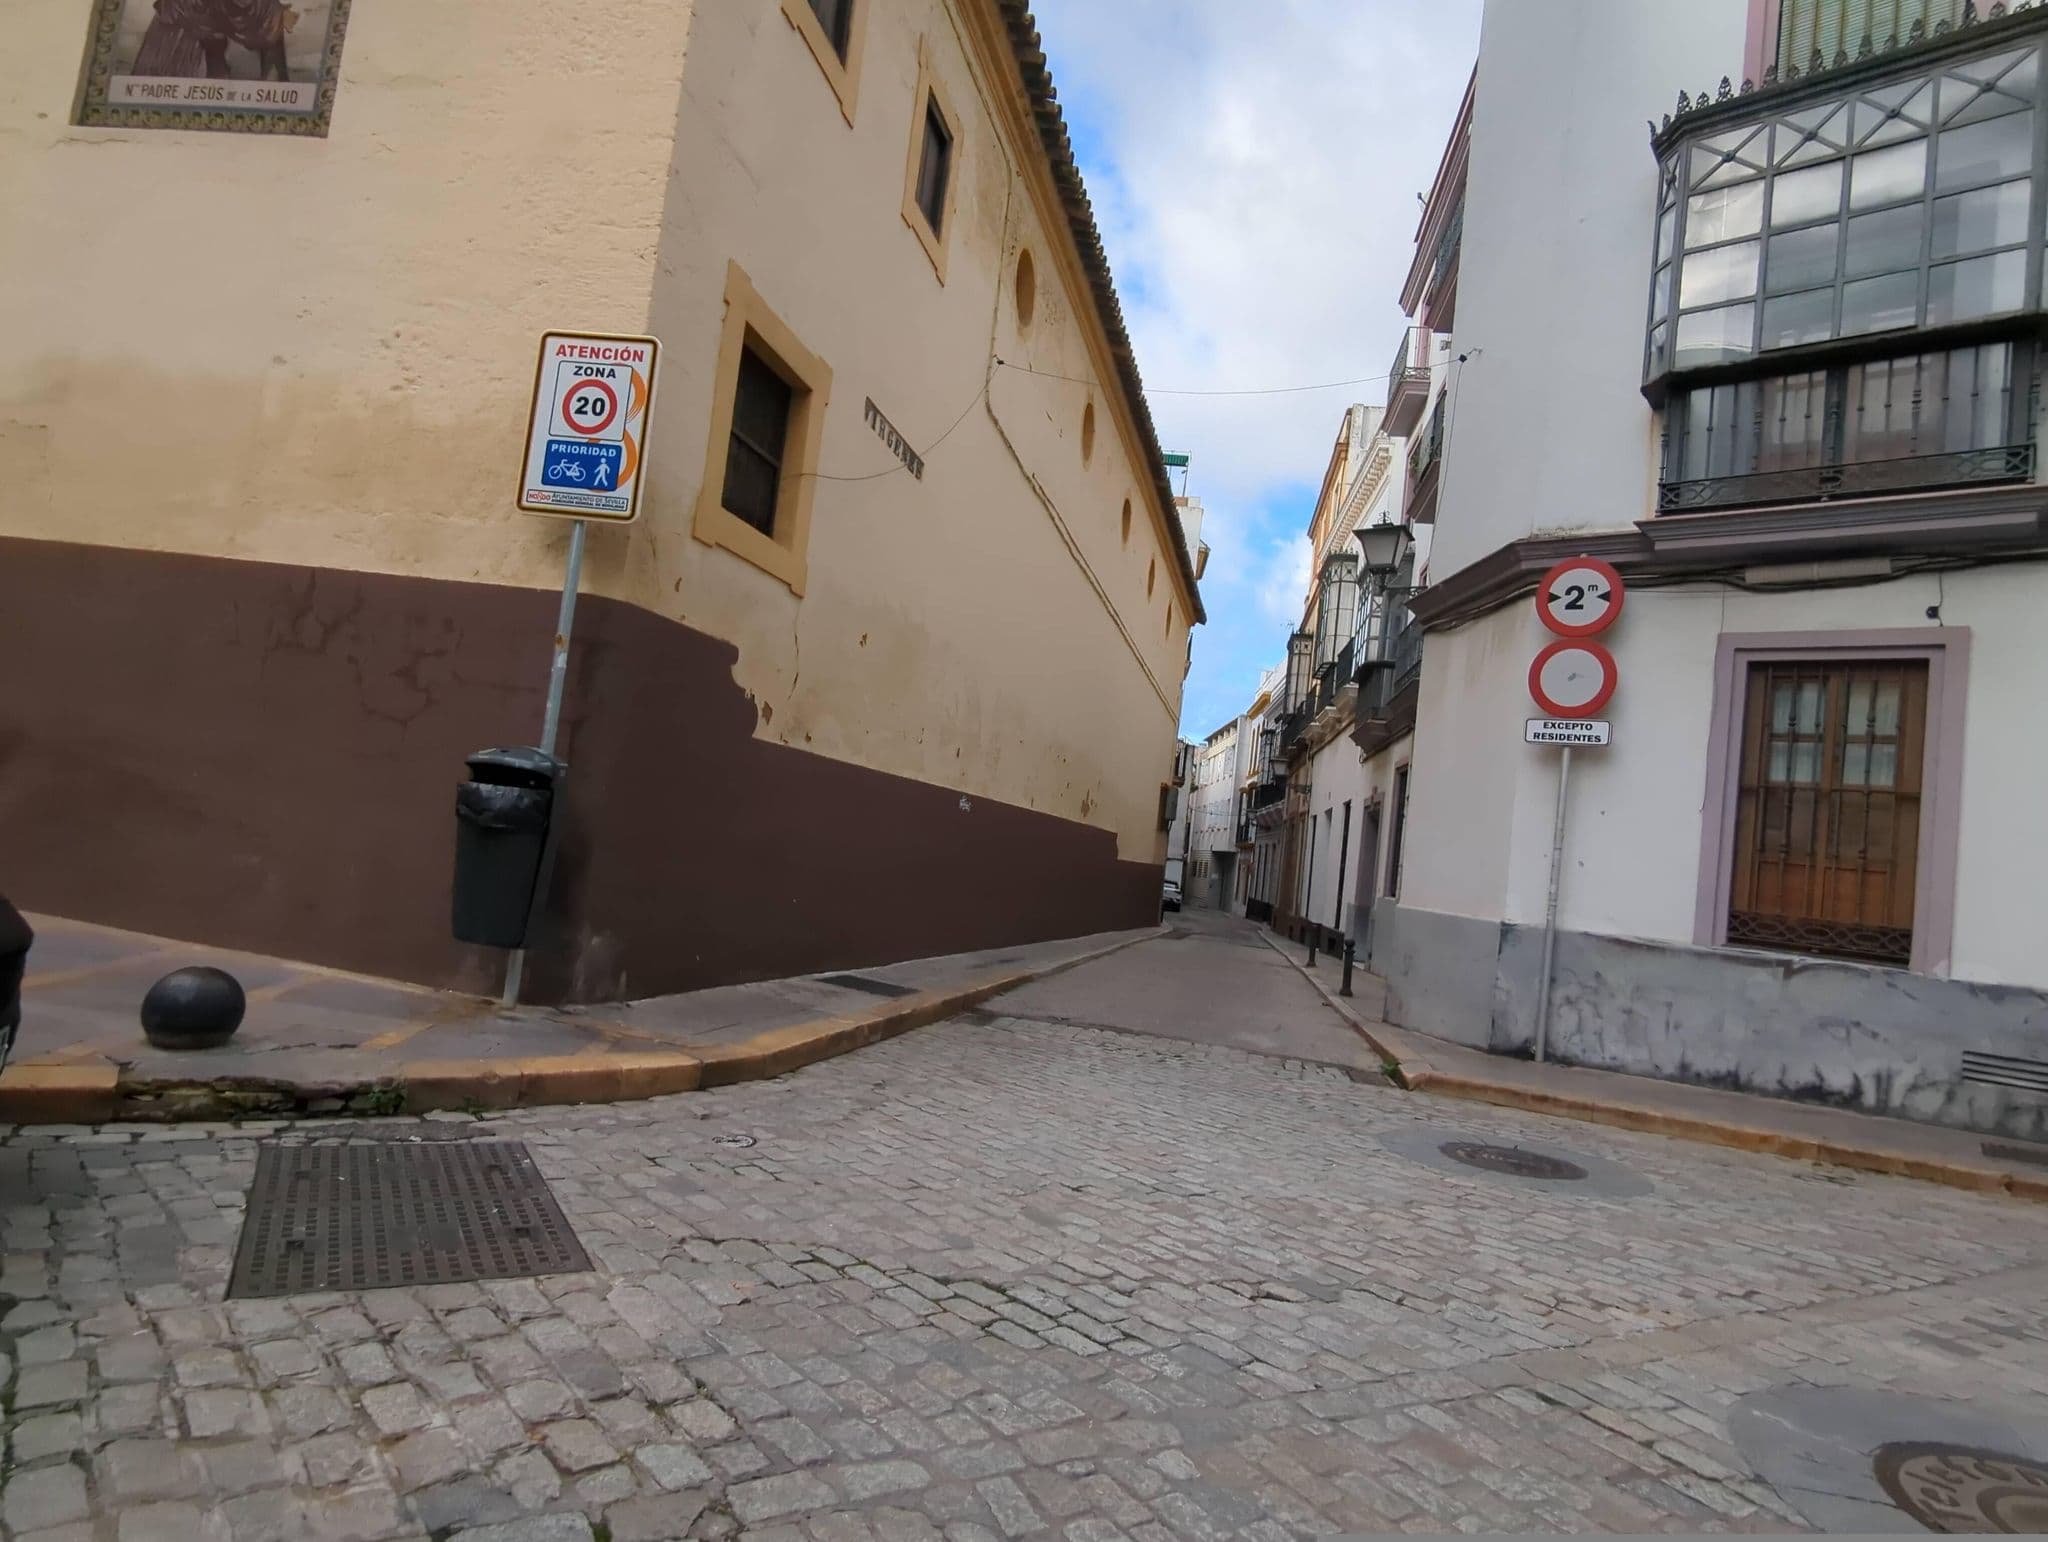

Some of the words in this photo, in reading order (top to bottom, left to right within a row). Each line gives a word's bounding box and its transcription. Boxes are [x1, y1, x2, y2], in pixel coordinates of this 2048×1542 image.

[141, 84, 179, 99] PADRE
[256, 89, 298, 104] SALUD
[556, 344, 644, 362] ATENCIÓN
[573, 365, 617, 379] ZONA
[574, 396, 606, 417] 20
[551, 443, 617, 457] PRIORIDAD
[1543, 721, 1593, 731] EXCEPTO
[1533, 732, 1601, 743] RESIDENTES
